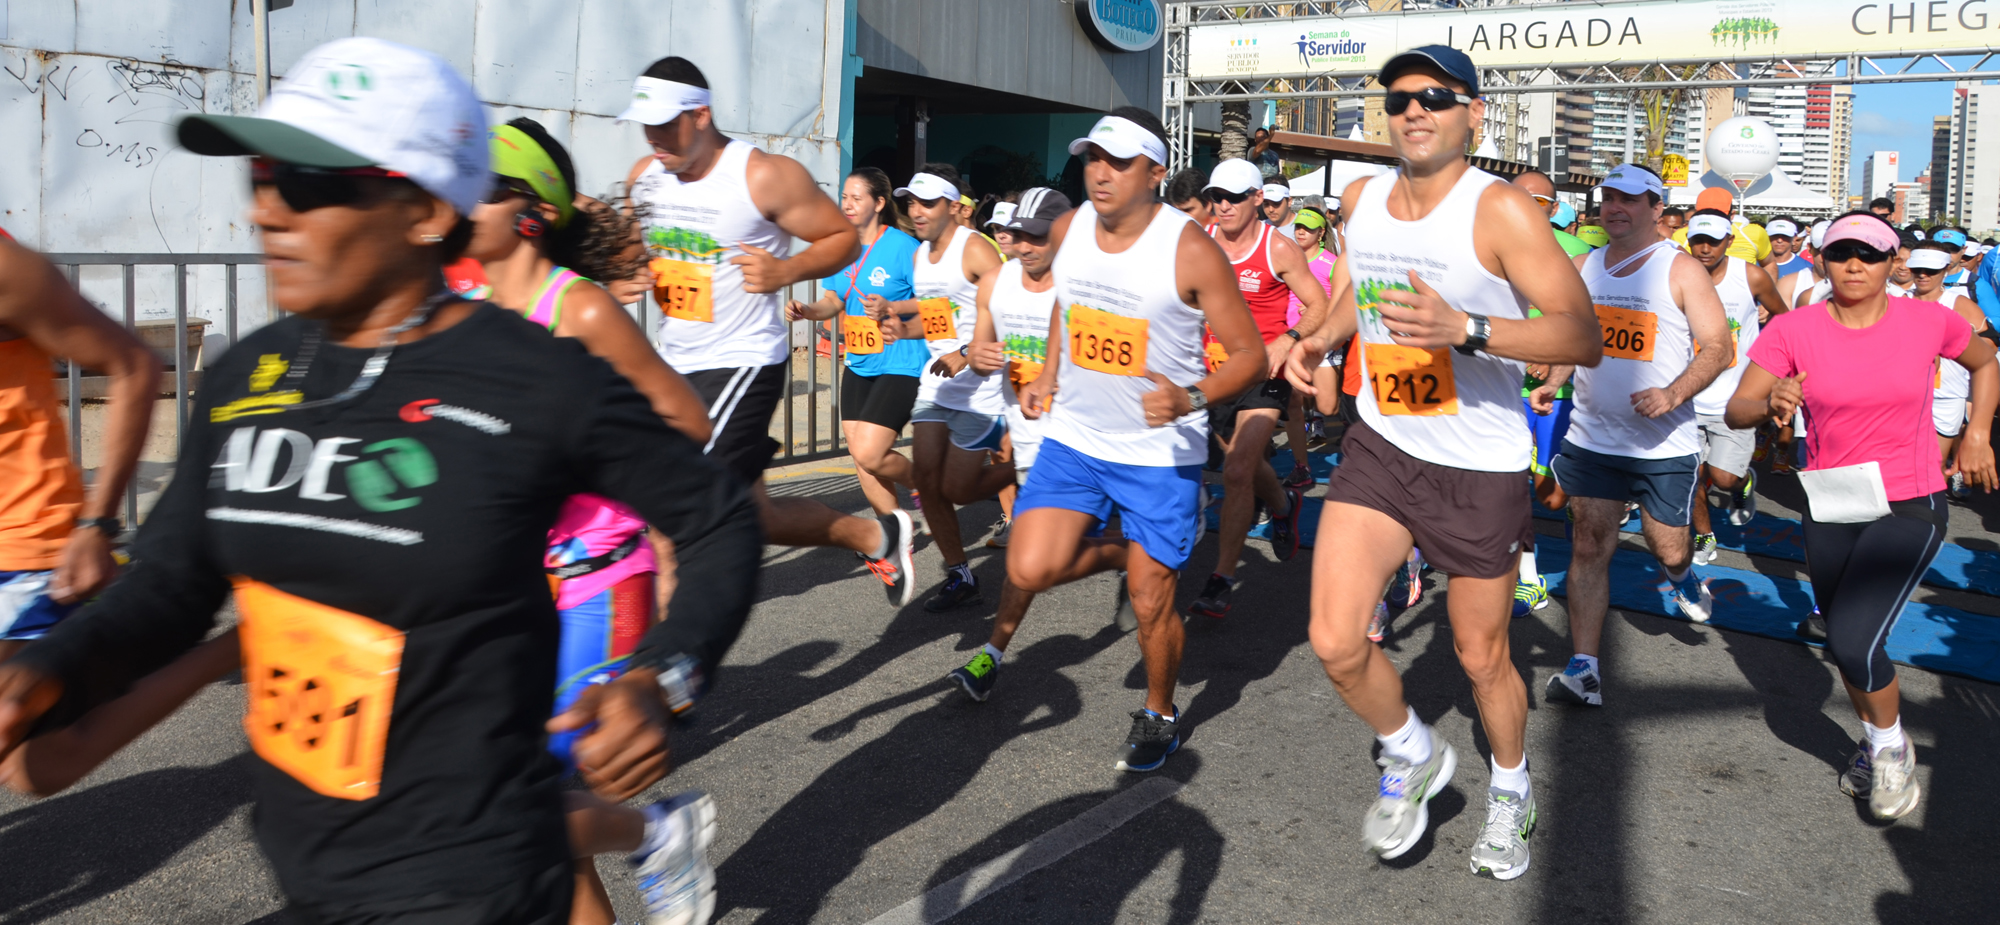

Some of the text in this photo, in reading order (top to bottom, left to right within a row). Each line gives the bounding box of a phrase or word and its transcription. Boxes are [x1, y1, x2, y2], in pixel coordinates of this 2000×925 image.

[1102, 0, 1153, 31] BOTECO
[1851, 0, 2000, 35] CHEG
[1308, 29, 1350, 40] Semana do
[1308, 39, 1366, 56] Servidor
[1448, 17, 1642, 51] LARGADA
[1227, 52, 1259, 60] SERVIDOR
[846, 331, 875, 347] 1216
[1074, 330, 1132, 366] 1368
[1600, 325, 1645, 352] 206
[1371, 372, 1442, 405] 1212
